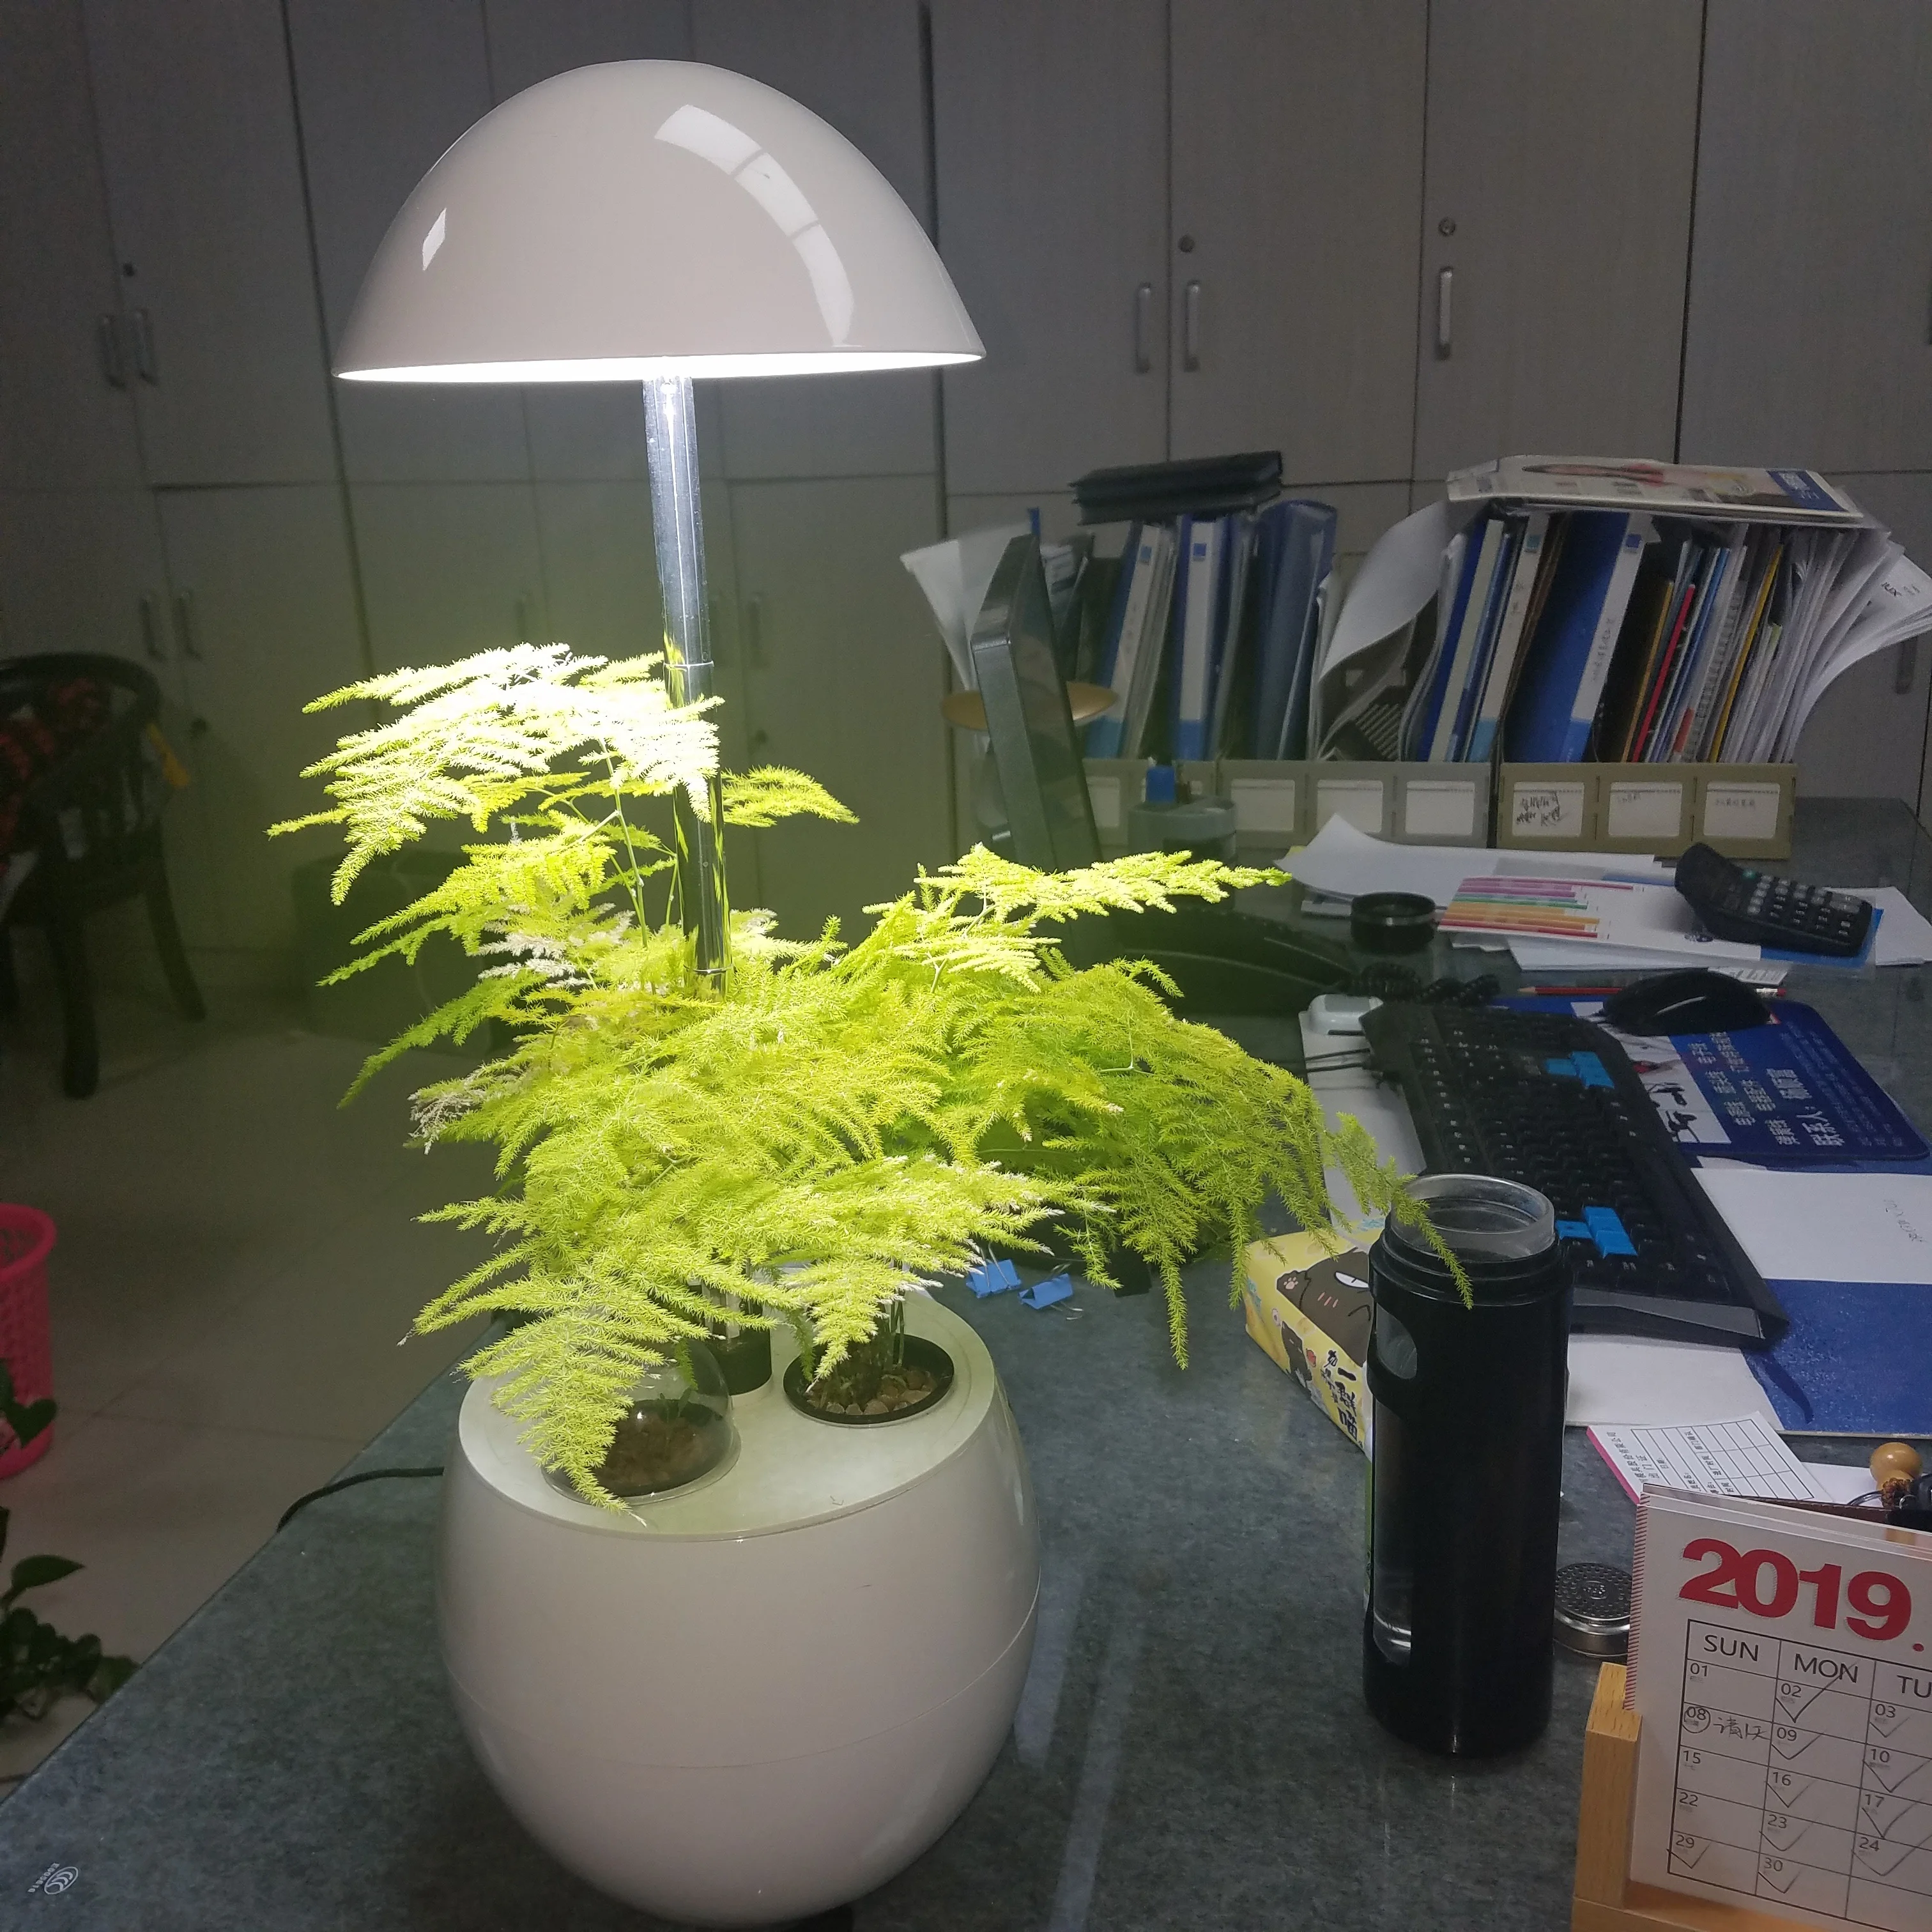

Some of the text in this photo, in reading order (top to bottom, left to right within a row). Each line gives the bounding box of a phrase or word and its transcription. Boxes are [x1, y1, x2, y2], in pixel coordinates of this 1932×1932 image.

[1703, 1634, 1759, 1662] SUN
[1794, 1653, 1858, 1683] MON
[1686, 1706, 1706, 1721] 08
[1690, 1662, 1896, 1719] 01 02 03
[1776, 1727, 1890, 1763] 09 10
[1683, 1750, 1885, 1808] 15 16 17
[1679, 1791, 1880, 1851] 22 23 24
[1675, 1834, 1783, 1872] 29 30
